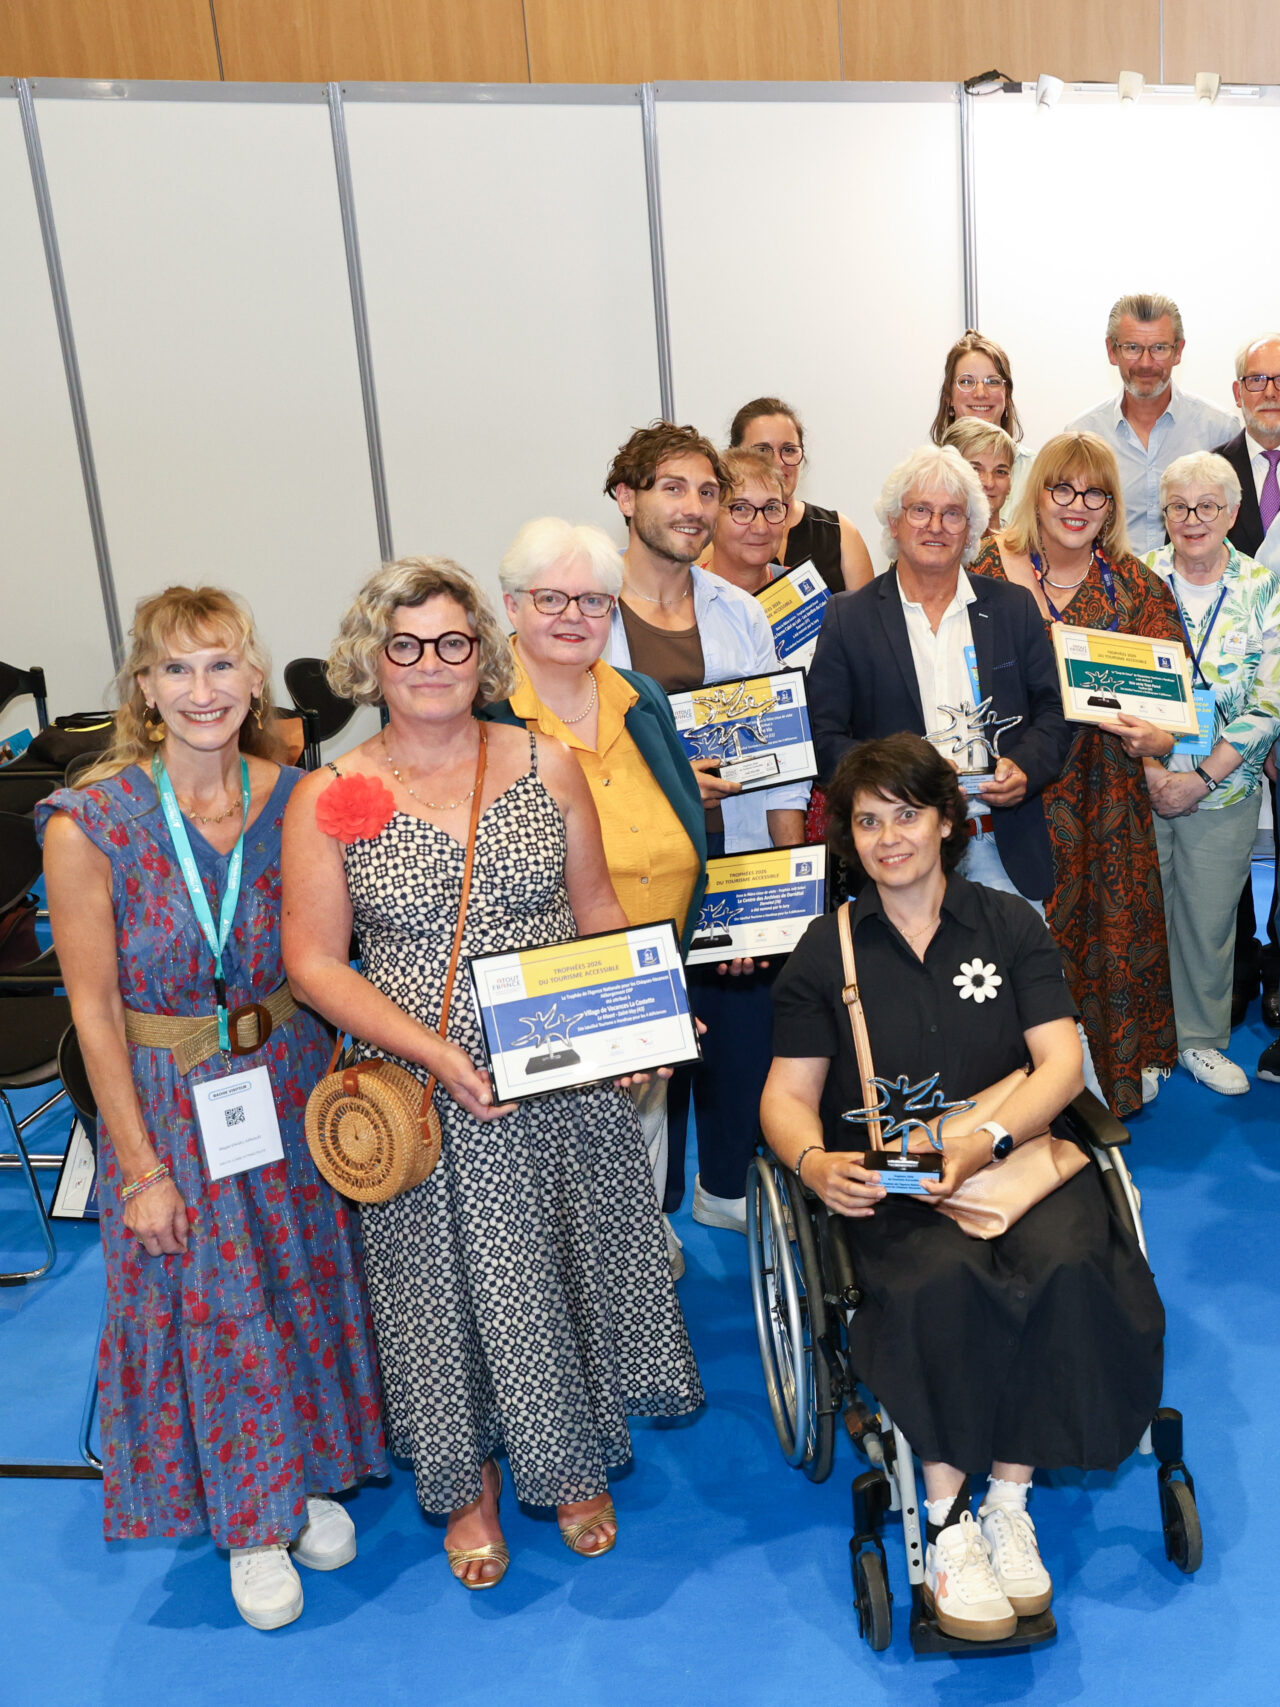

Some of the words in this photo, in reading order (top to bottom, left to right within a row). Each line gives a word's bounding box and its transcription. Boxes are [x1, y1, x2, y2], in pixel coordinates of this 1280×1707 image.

[554, 963, 586, 974] TROPHÉES
[586, 960, 603, 968] 2026
[550, 972, 583, 983] TOURISME
[584, 964, 620, 976] ACCESSIBLE
[492, 980, 521, 990] FRANCE
[496, 975, 520, 985] ATOUT
[584, 1008, 601, 1018] Village
